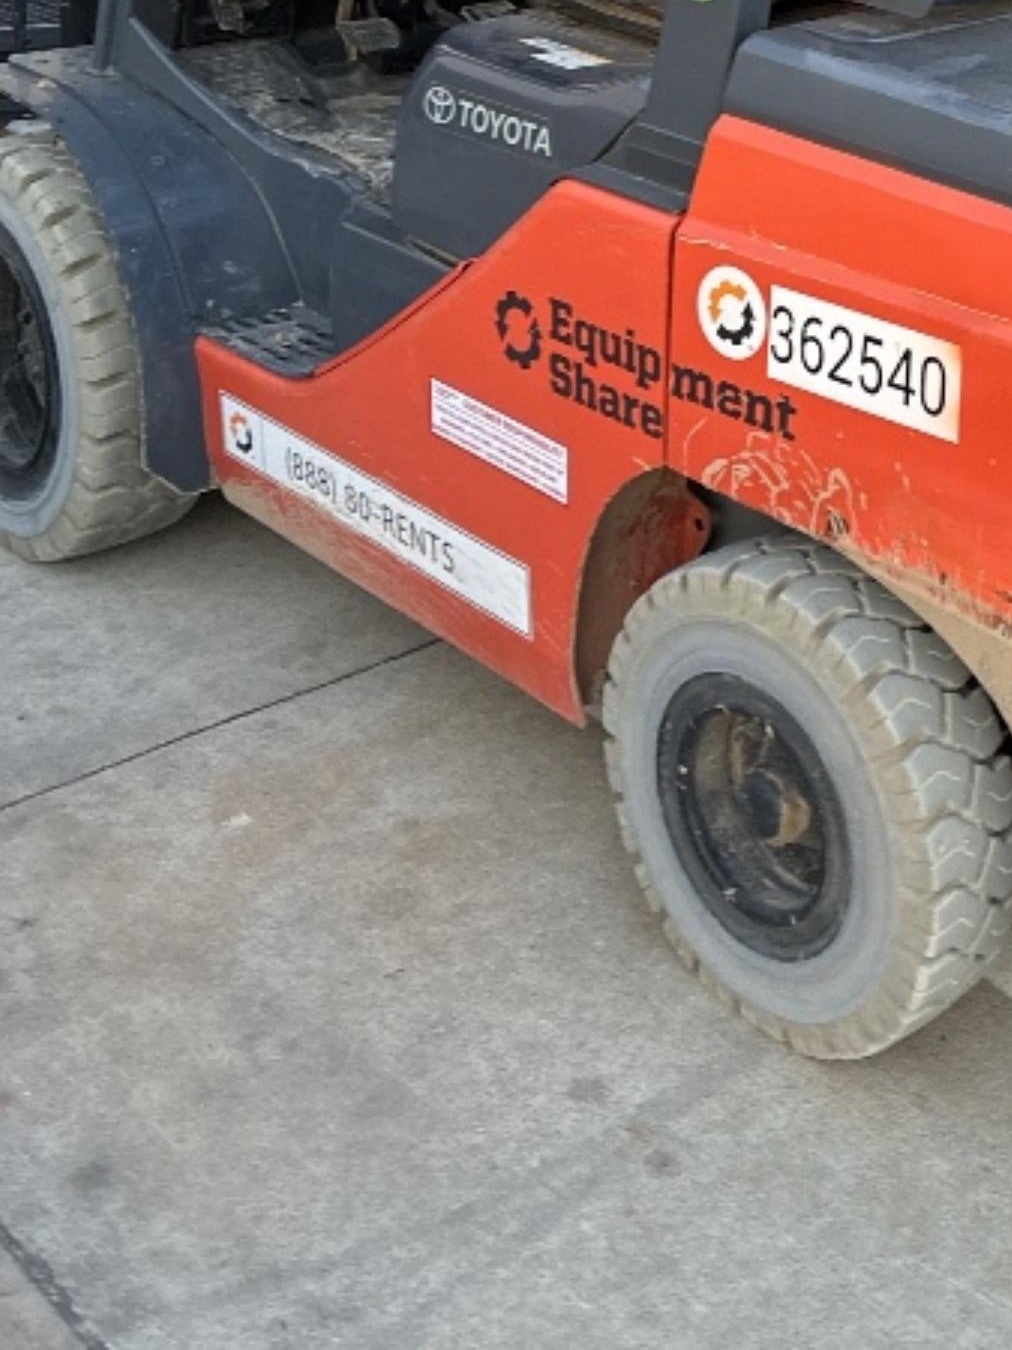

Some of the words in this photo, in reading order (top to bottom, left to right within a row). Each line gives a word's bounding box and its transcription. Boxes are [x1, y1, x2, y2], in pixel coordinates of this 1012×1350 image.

[458, 100, 552, 157] TOYOTA
[549, 352, 664, 439] Share
[770, 305, 947, 417] 362540
[285, 447, 337, 504] (888)
